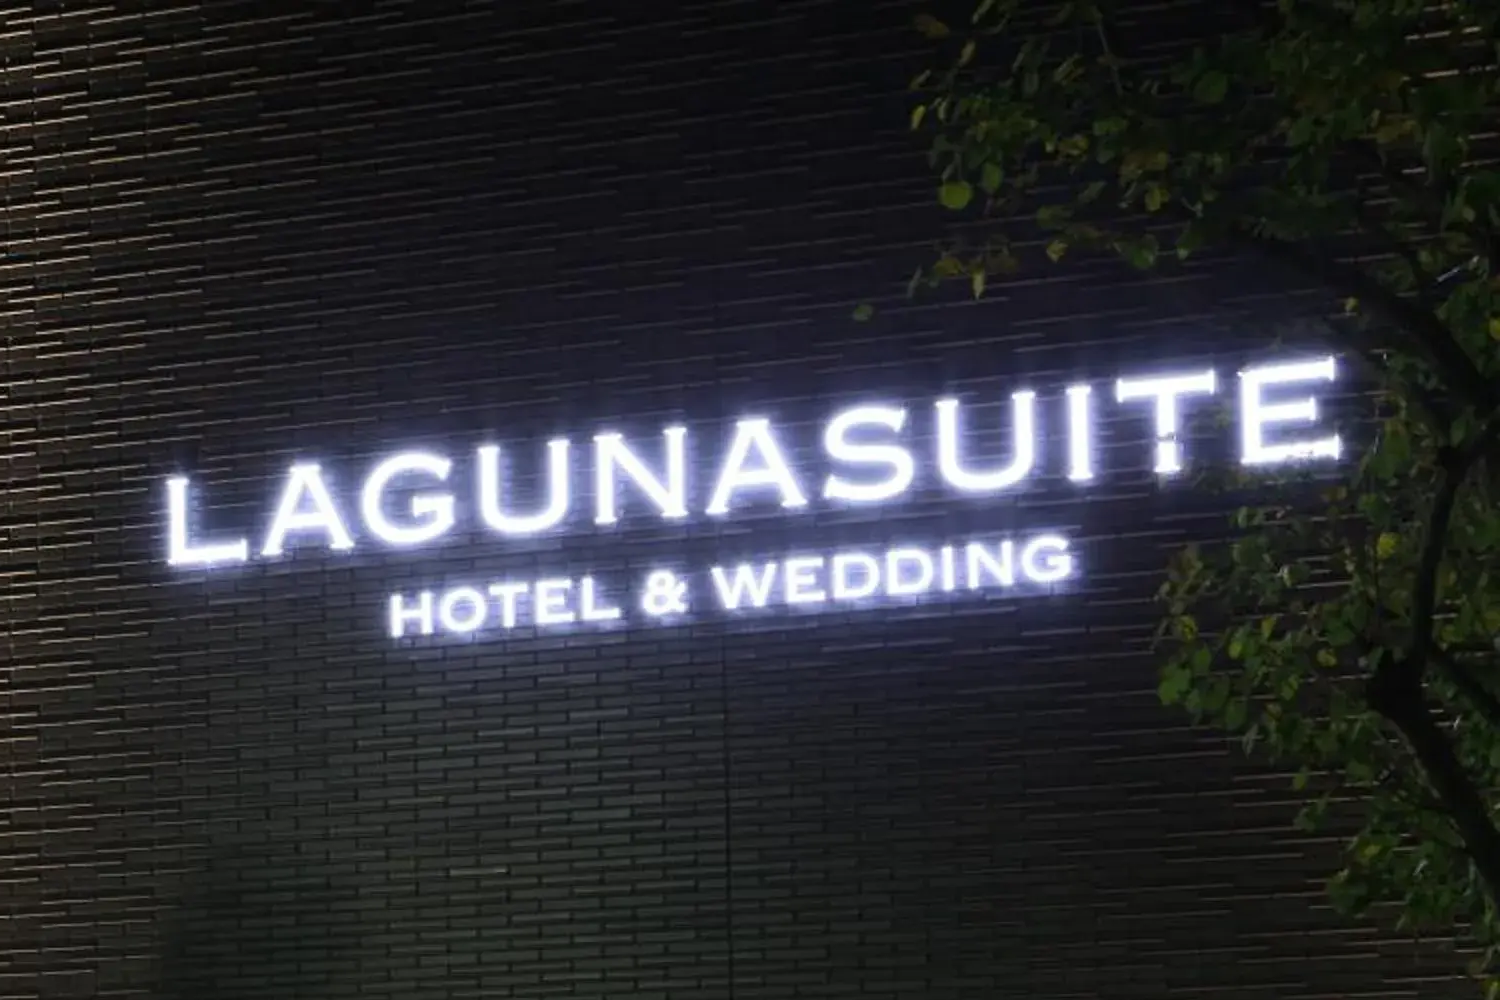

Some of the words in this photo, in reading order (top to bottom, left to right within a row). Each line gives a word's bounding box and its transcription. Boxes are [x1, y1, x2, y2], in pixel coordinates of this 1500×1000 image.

[166, 356, 1342, 566] LAGUNASUITE
[389, 576, 622, 638] HOTEL
[641, 569, 689, 617] &
[711, 533, 1073, 610] WEDDING
